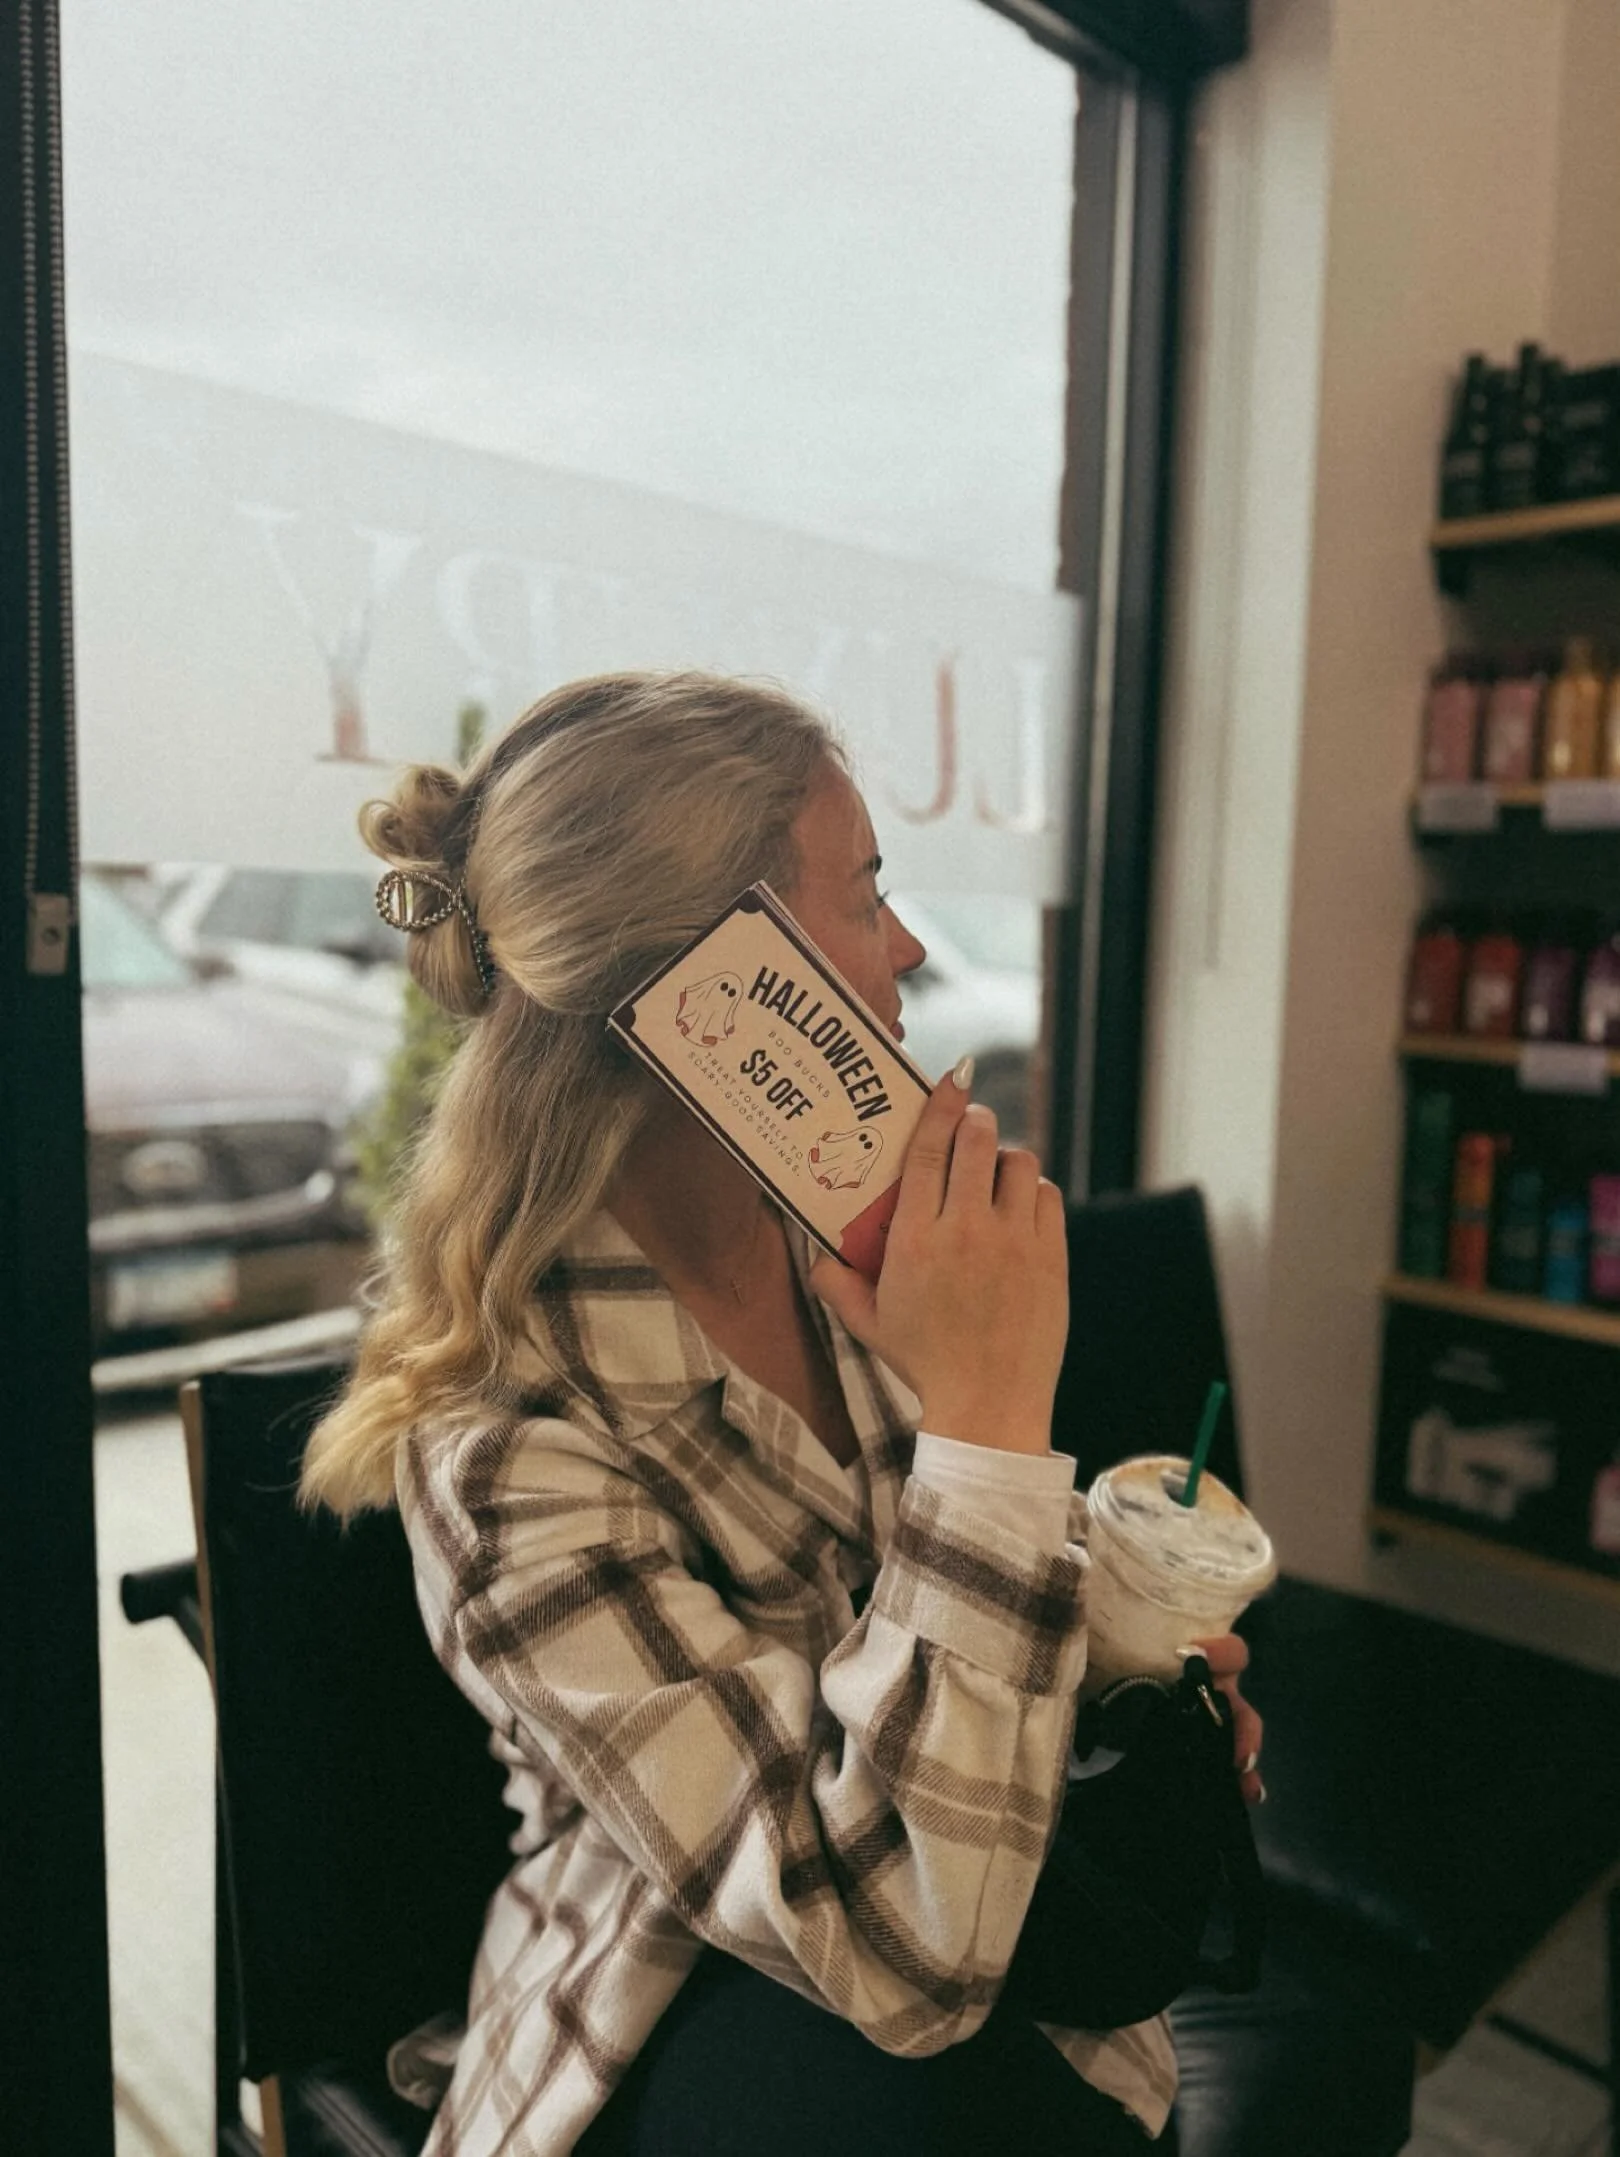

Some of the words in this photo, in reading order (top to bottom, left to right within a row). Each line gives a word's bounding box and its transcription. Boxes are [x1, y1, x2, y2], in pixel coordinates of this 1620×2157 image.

[740, 1049, 778, 1087] $5
[766, 1077, 813, 1121] OFF
[748, 966, 892, 1121] HALLOWEEN
[768, 1031, 792, 1056] BOO
[794, 1060, 830, 1099] BUCKS
[704, 1052, 736, 1086] TREAT
[738, 1088, 788, 1142] YOURSELF
[790, 1145, 804, 1160] TO
